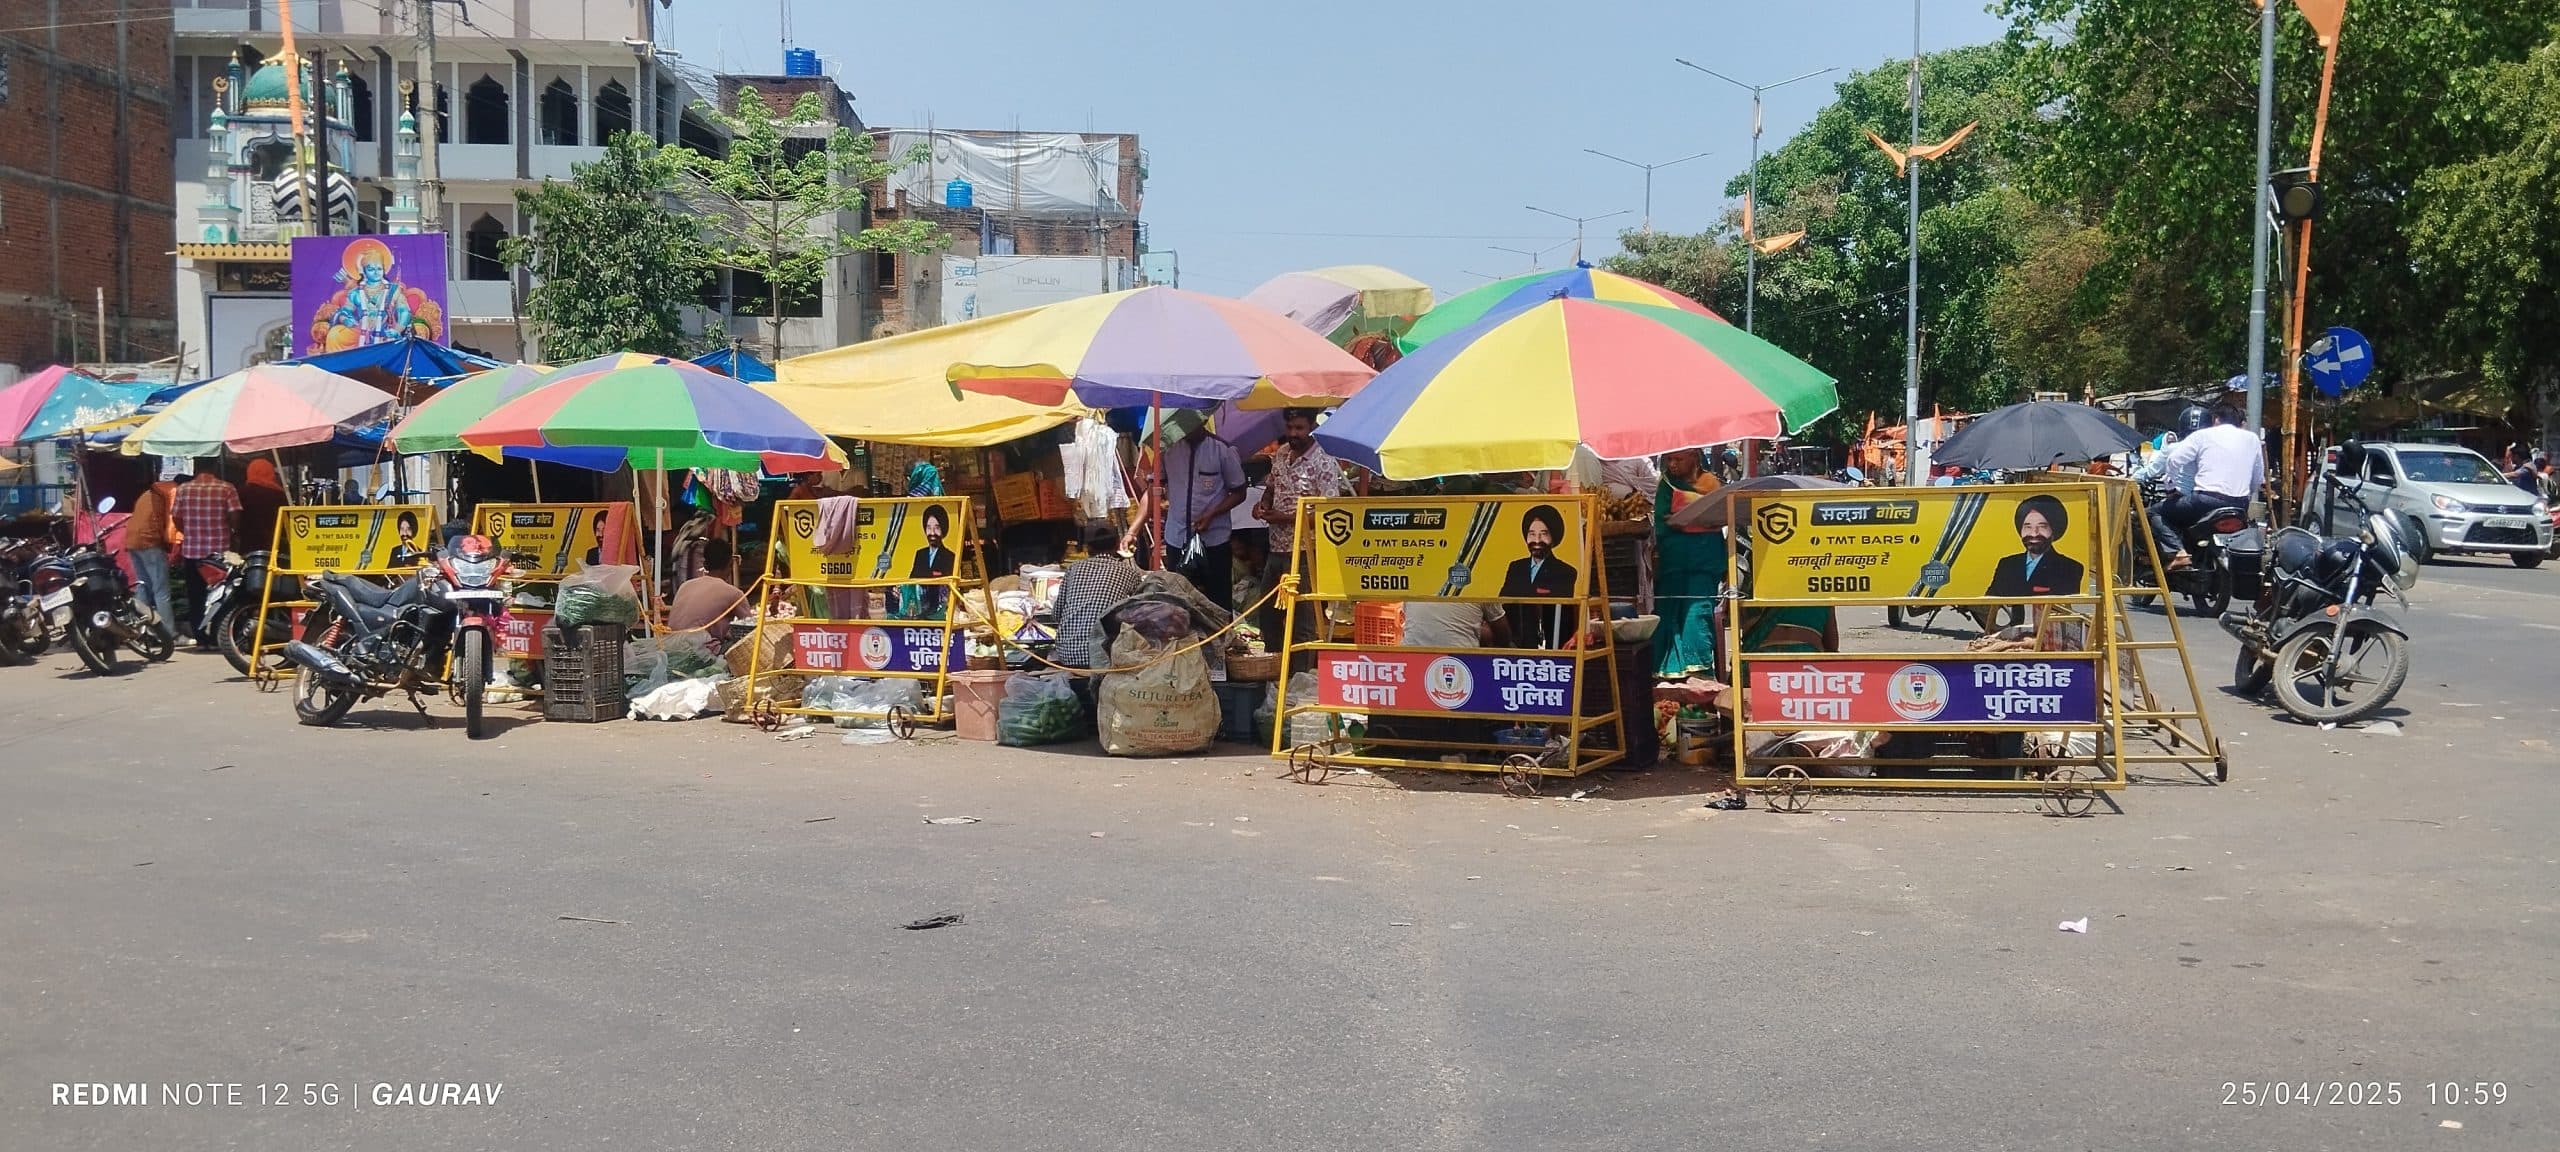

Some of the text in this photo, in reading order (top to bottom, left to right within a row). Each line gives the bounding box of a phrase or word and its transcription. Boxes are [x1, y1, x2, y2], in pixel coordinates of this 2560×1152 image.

[1413, 509, 1442, 525] गोल्ड
[1876, 503, 1914, 520] गोल्ड
[1375, 539, 1435, 548] TMT BARS
[1826, 535, 1904, 545] TMT BARS
[820, 562, 852, 575] SG600
[1834, 554, 1879, 570] सबकुछ
[1361, 575, 1409, 590] SG600
[1807, 576, 1871, 593] SG600
[798, 627, 848, 649] बगोदर
[806, 651, 843, 668] थाना
[1331, 655, 1408, 684] बगोदर
[1492, 658, 1573, 683] गिरिडीह
[1973, 663, 2074, 688] गिरिडीह
[1767, 665, 1865, 694] बगोदर
[1342, 684, 1398, 706] थाना
[1501, 683, 1565, 711] पुलिस
[1983, 689, 2064, 720] पुलिस
[1781, 698, 1853, 720] थाना
